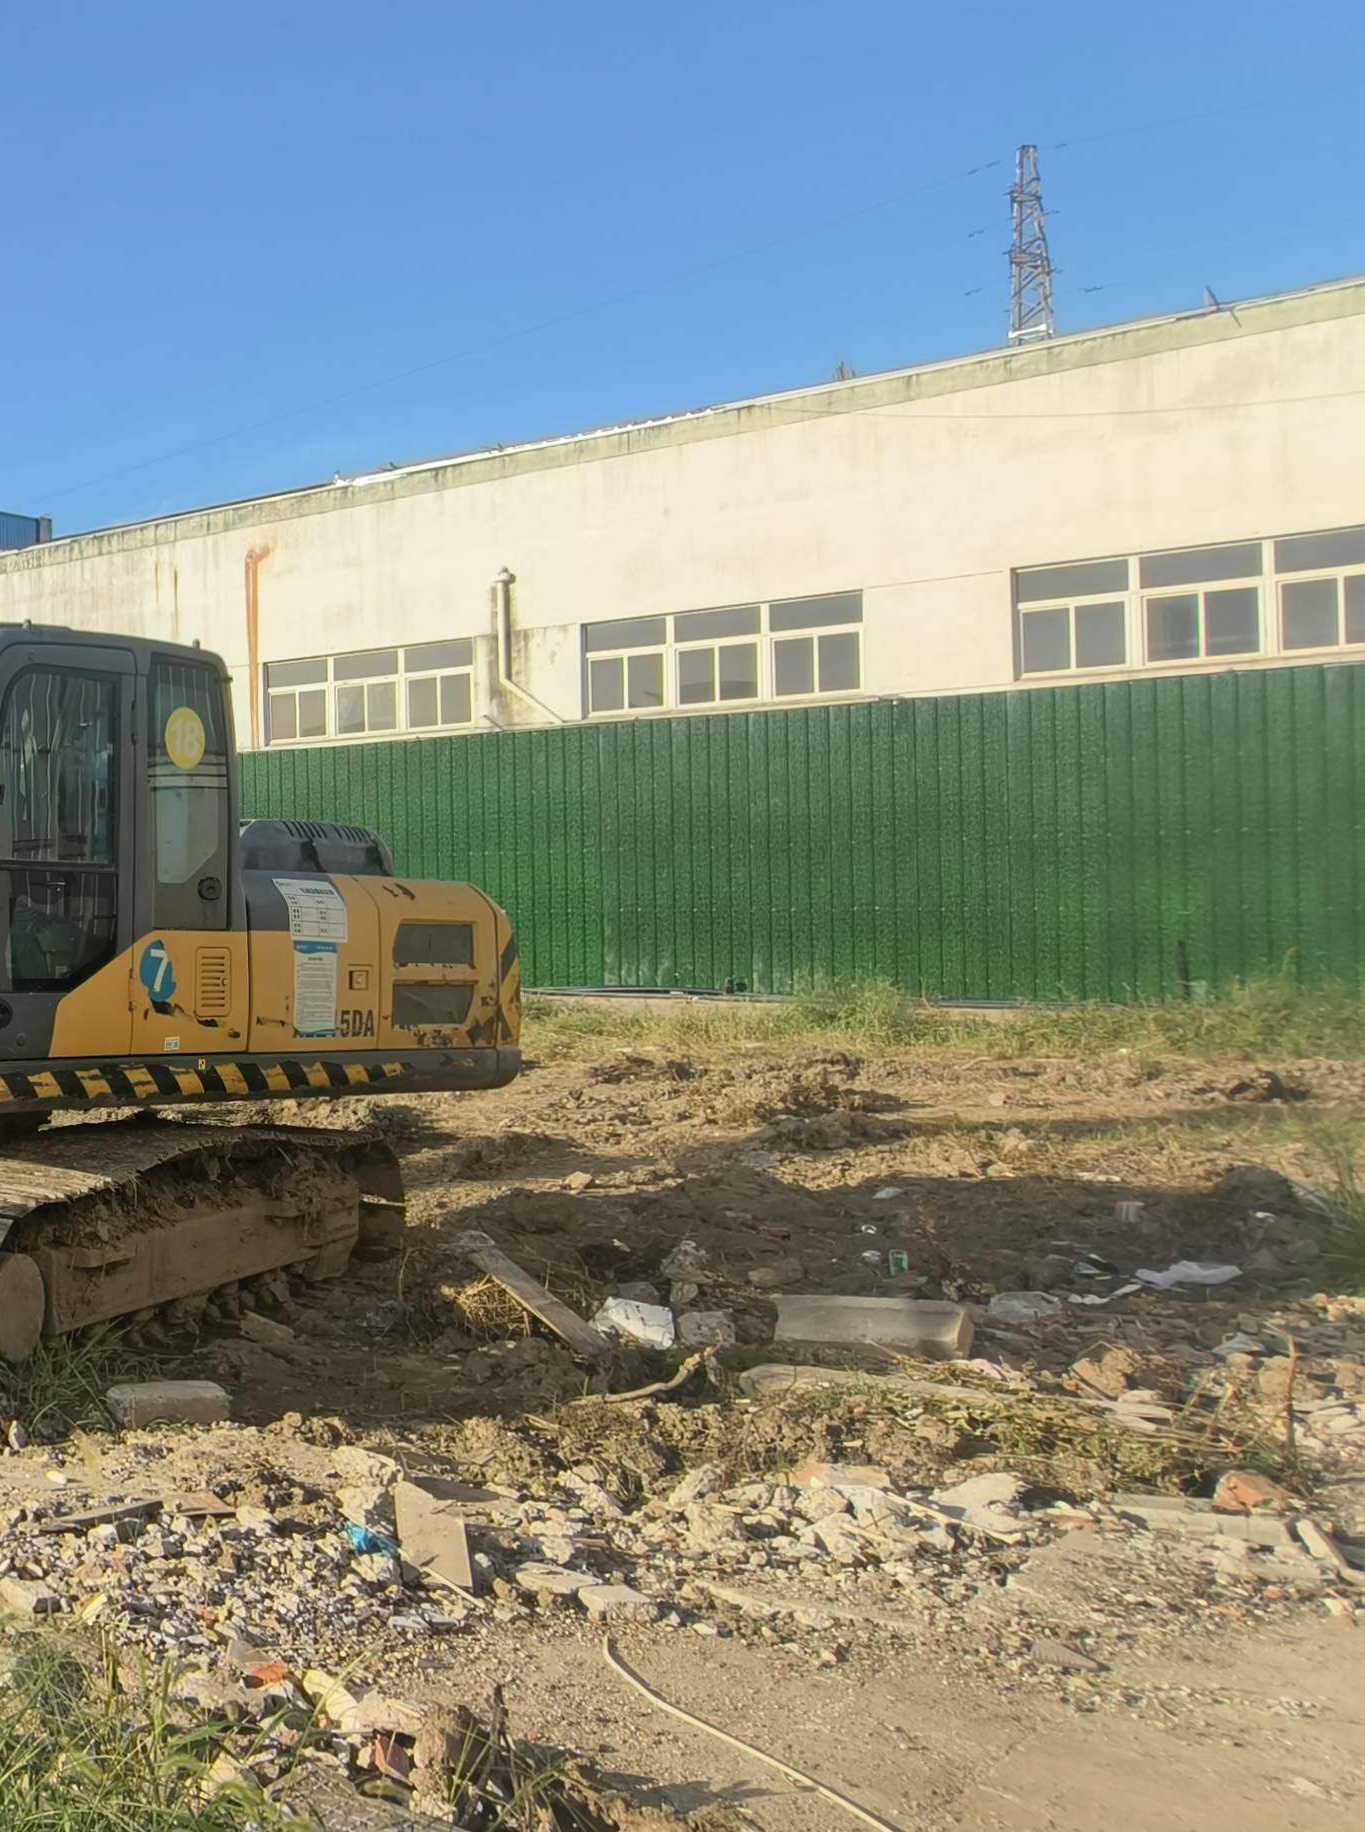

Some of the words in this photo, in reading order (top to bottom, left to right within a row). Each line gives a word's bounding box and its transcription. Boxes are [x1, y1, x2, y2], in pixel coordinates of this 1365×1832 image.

[172, 720, 199, 757] 18
[150, 948, 169, 992] 7
[335, 1010, 374, 1038] 5DA
